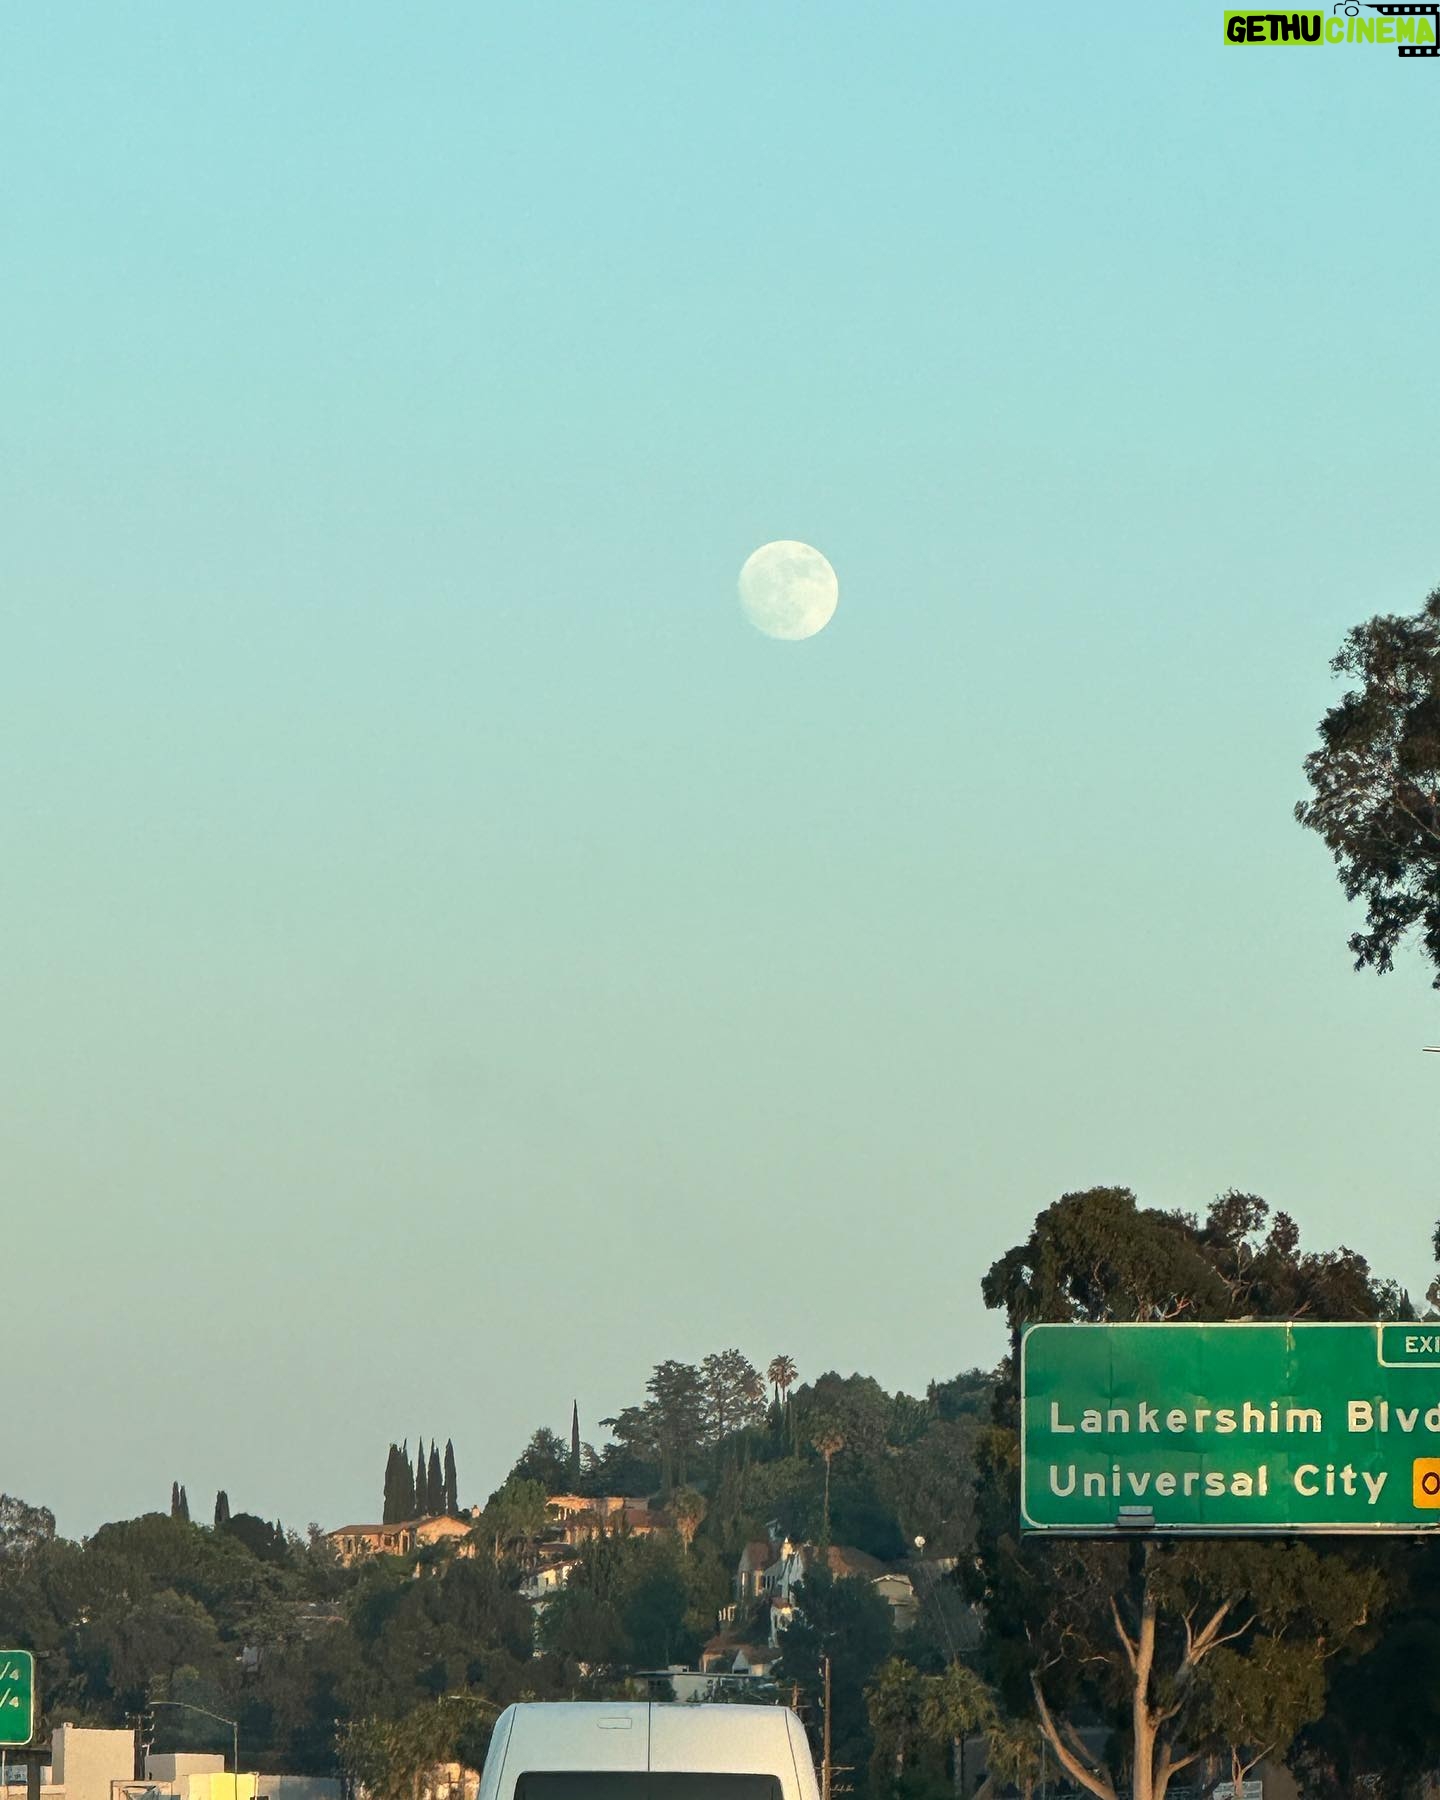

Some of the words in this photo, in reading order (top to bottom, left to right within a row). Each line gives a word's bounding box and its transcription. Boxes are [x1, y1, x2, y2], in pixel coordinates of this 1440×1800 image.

[1050, 1401, 1322, 1433] Lankershim
[1049, 1464, 1268, 1496] Universal
[1294, 1463, 1388, 1505] City
